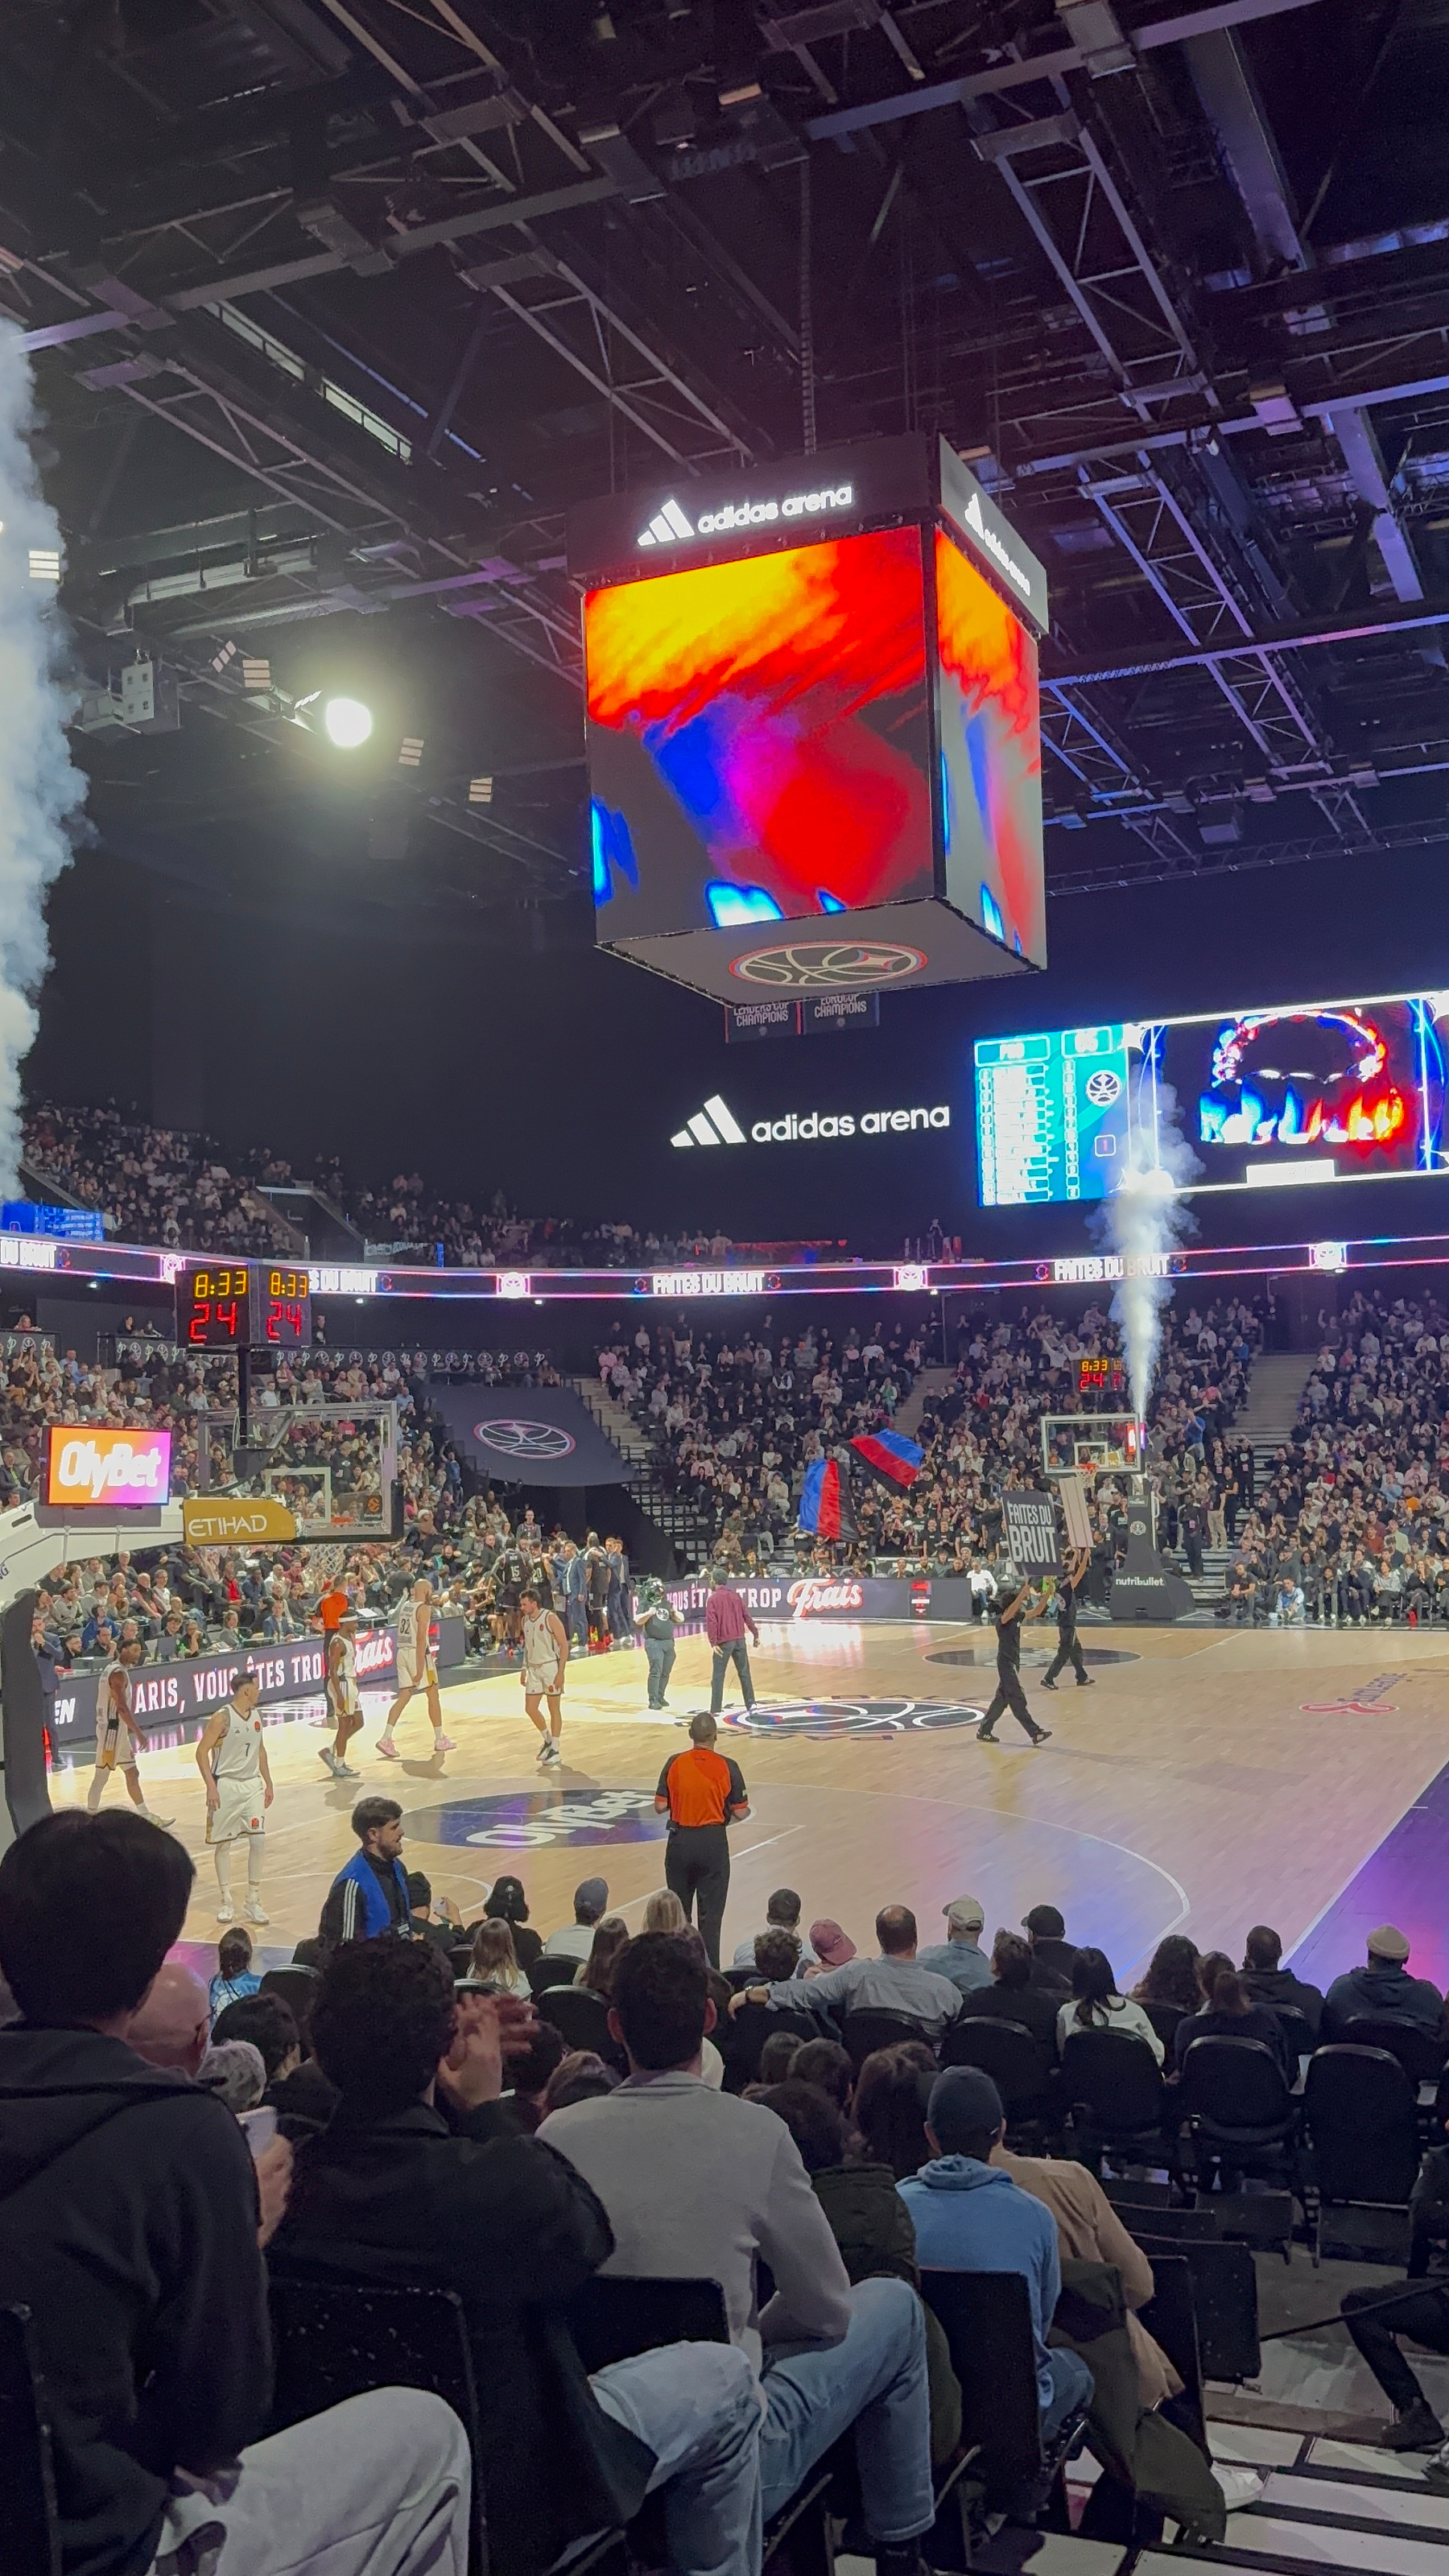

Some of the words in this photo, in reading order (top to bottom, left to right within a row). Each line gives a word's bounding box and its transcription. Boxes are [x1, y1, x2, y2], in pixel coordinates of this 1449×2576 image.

[697, 501, 779, 535] adidas
[782, 486, 853, 518] arena
[814, 1001, 868, 1019] CHAMPIONS
[820, 993, 860, 1006] EUROCUP
[736, 1009, 789, 1028] CHAMPIONS
[751, 1113, 856, 1144] adidas
[860, 1105, 950, 1132] arena
[1054, 1258, 1104, 1282] FAITES
[1104, 1256, 1125, 1278] DU
[1127, 1255, 1170, 1278] BRUIT
[194, 1270, 247, 1298] 8:33
[270, 1271, 308, 1298] 8:33
[701, 1272, 721, 1293] DU
[723, 1272, 765, 1293] BRUIT
[188, 1301, 237, 1340] 24
[266, 1300, 301, 1338] 24
[1081, 1360, 1108, 1373] 8:33
[1080, 1373, 1104, 1389] 24
[59, 1440, 162, 1498] OlyBet
[188, 1513, 268, 1538] ETIHAD
[1006, 1503, 1038, 1525] FAITES
[1038, 1505, 1052, 1525] DU
[1009, 1525, 1058, 1563] BRUIT
[736, 1587, 782, 1608] TROP
[787, 1578, 863, 1617] Frais
[399, 1618, 411, 1635] 32
[134, 1677, 186, 1714] ARIS,
[291, 1647, 325, 1684] TRO
[245, 1743, 251, 1757] 7
